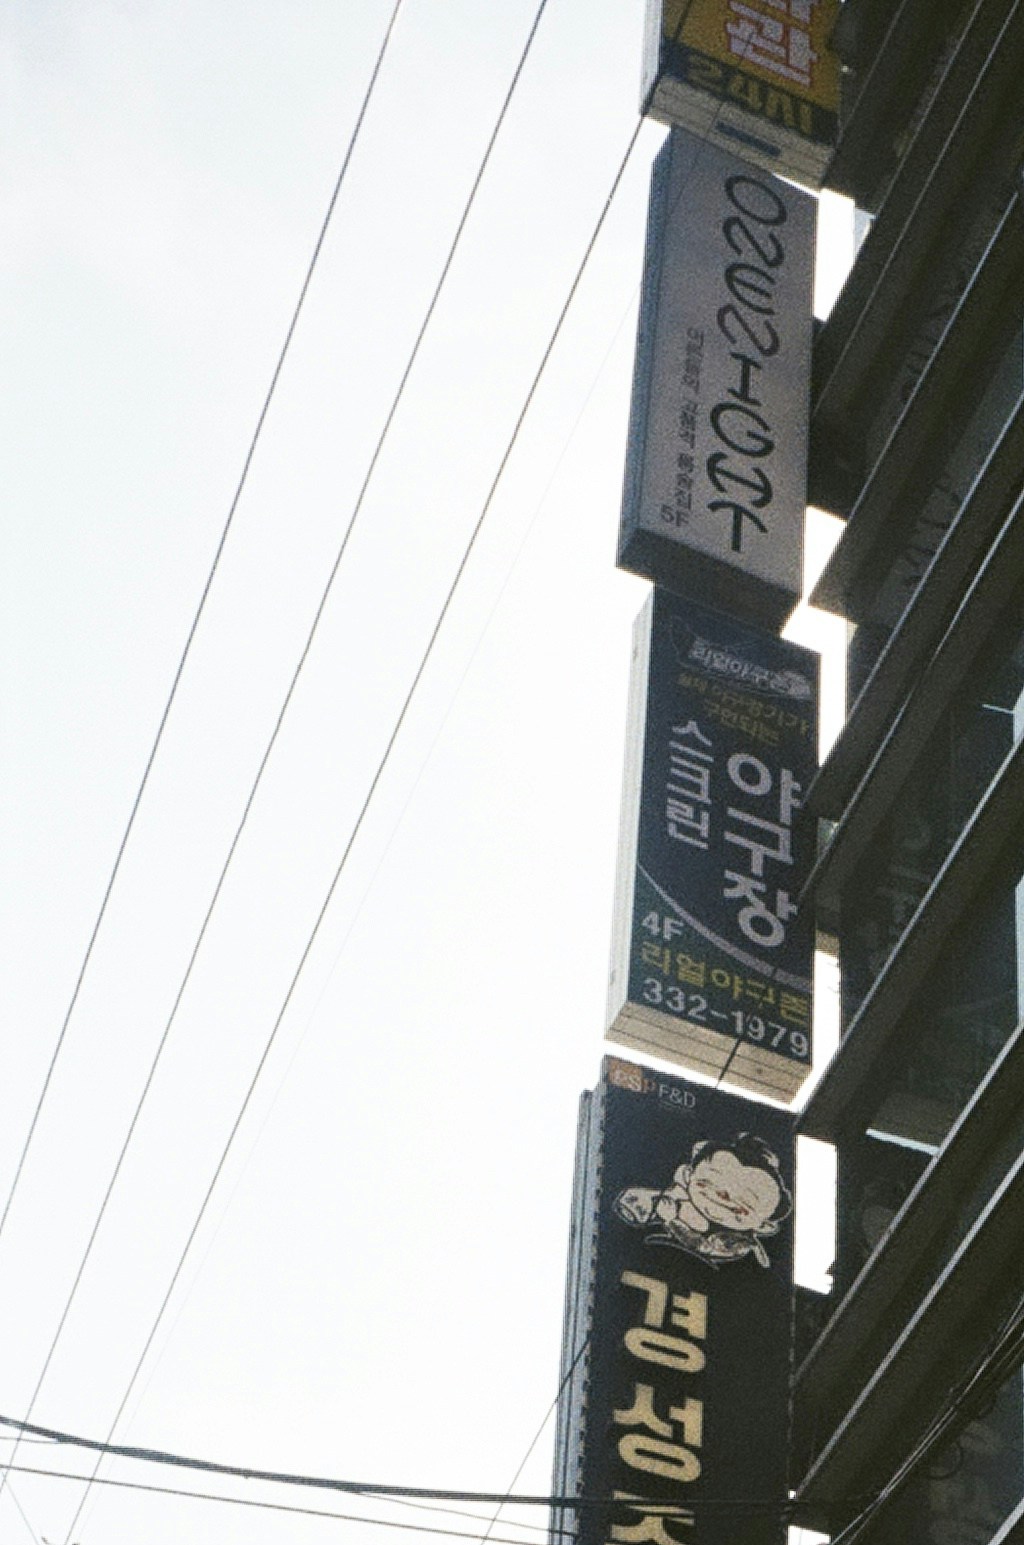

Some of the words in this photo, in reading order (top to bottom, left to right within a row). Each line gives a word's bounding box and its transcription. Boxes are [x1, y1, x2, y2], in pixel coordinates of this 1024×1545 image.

[665, 719, 715, 850] 스크린
[723, 751, 802, 949] 야구장
[641, 911, 685, 941] 4F
[643, 977, 810, 1058] 332-1979
